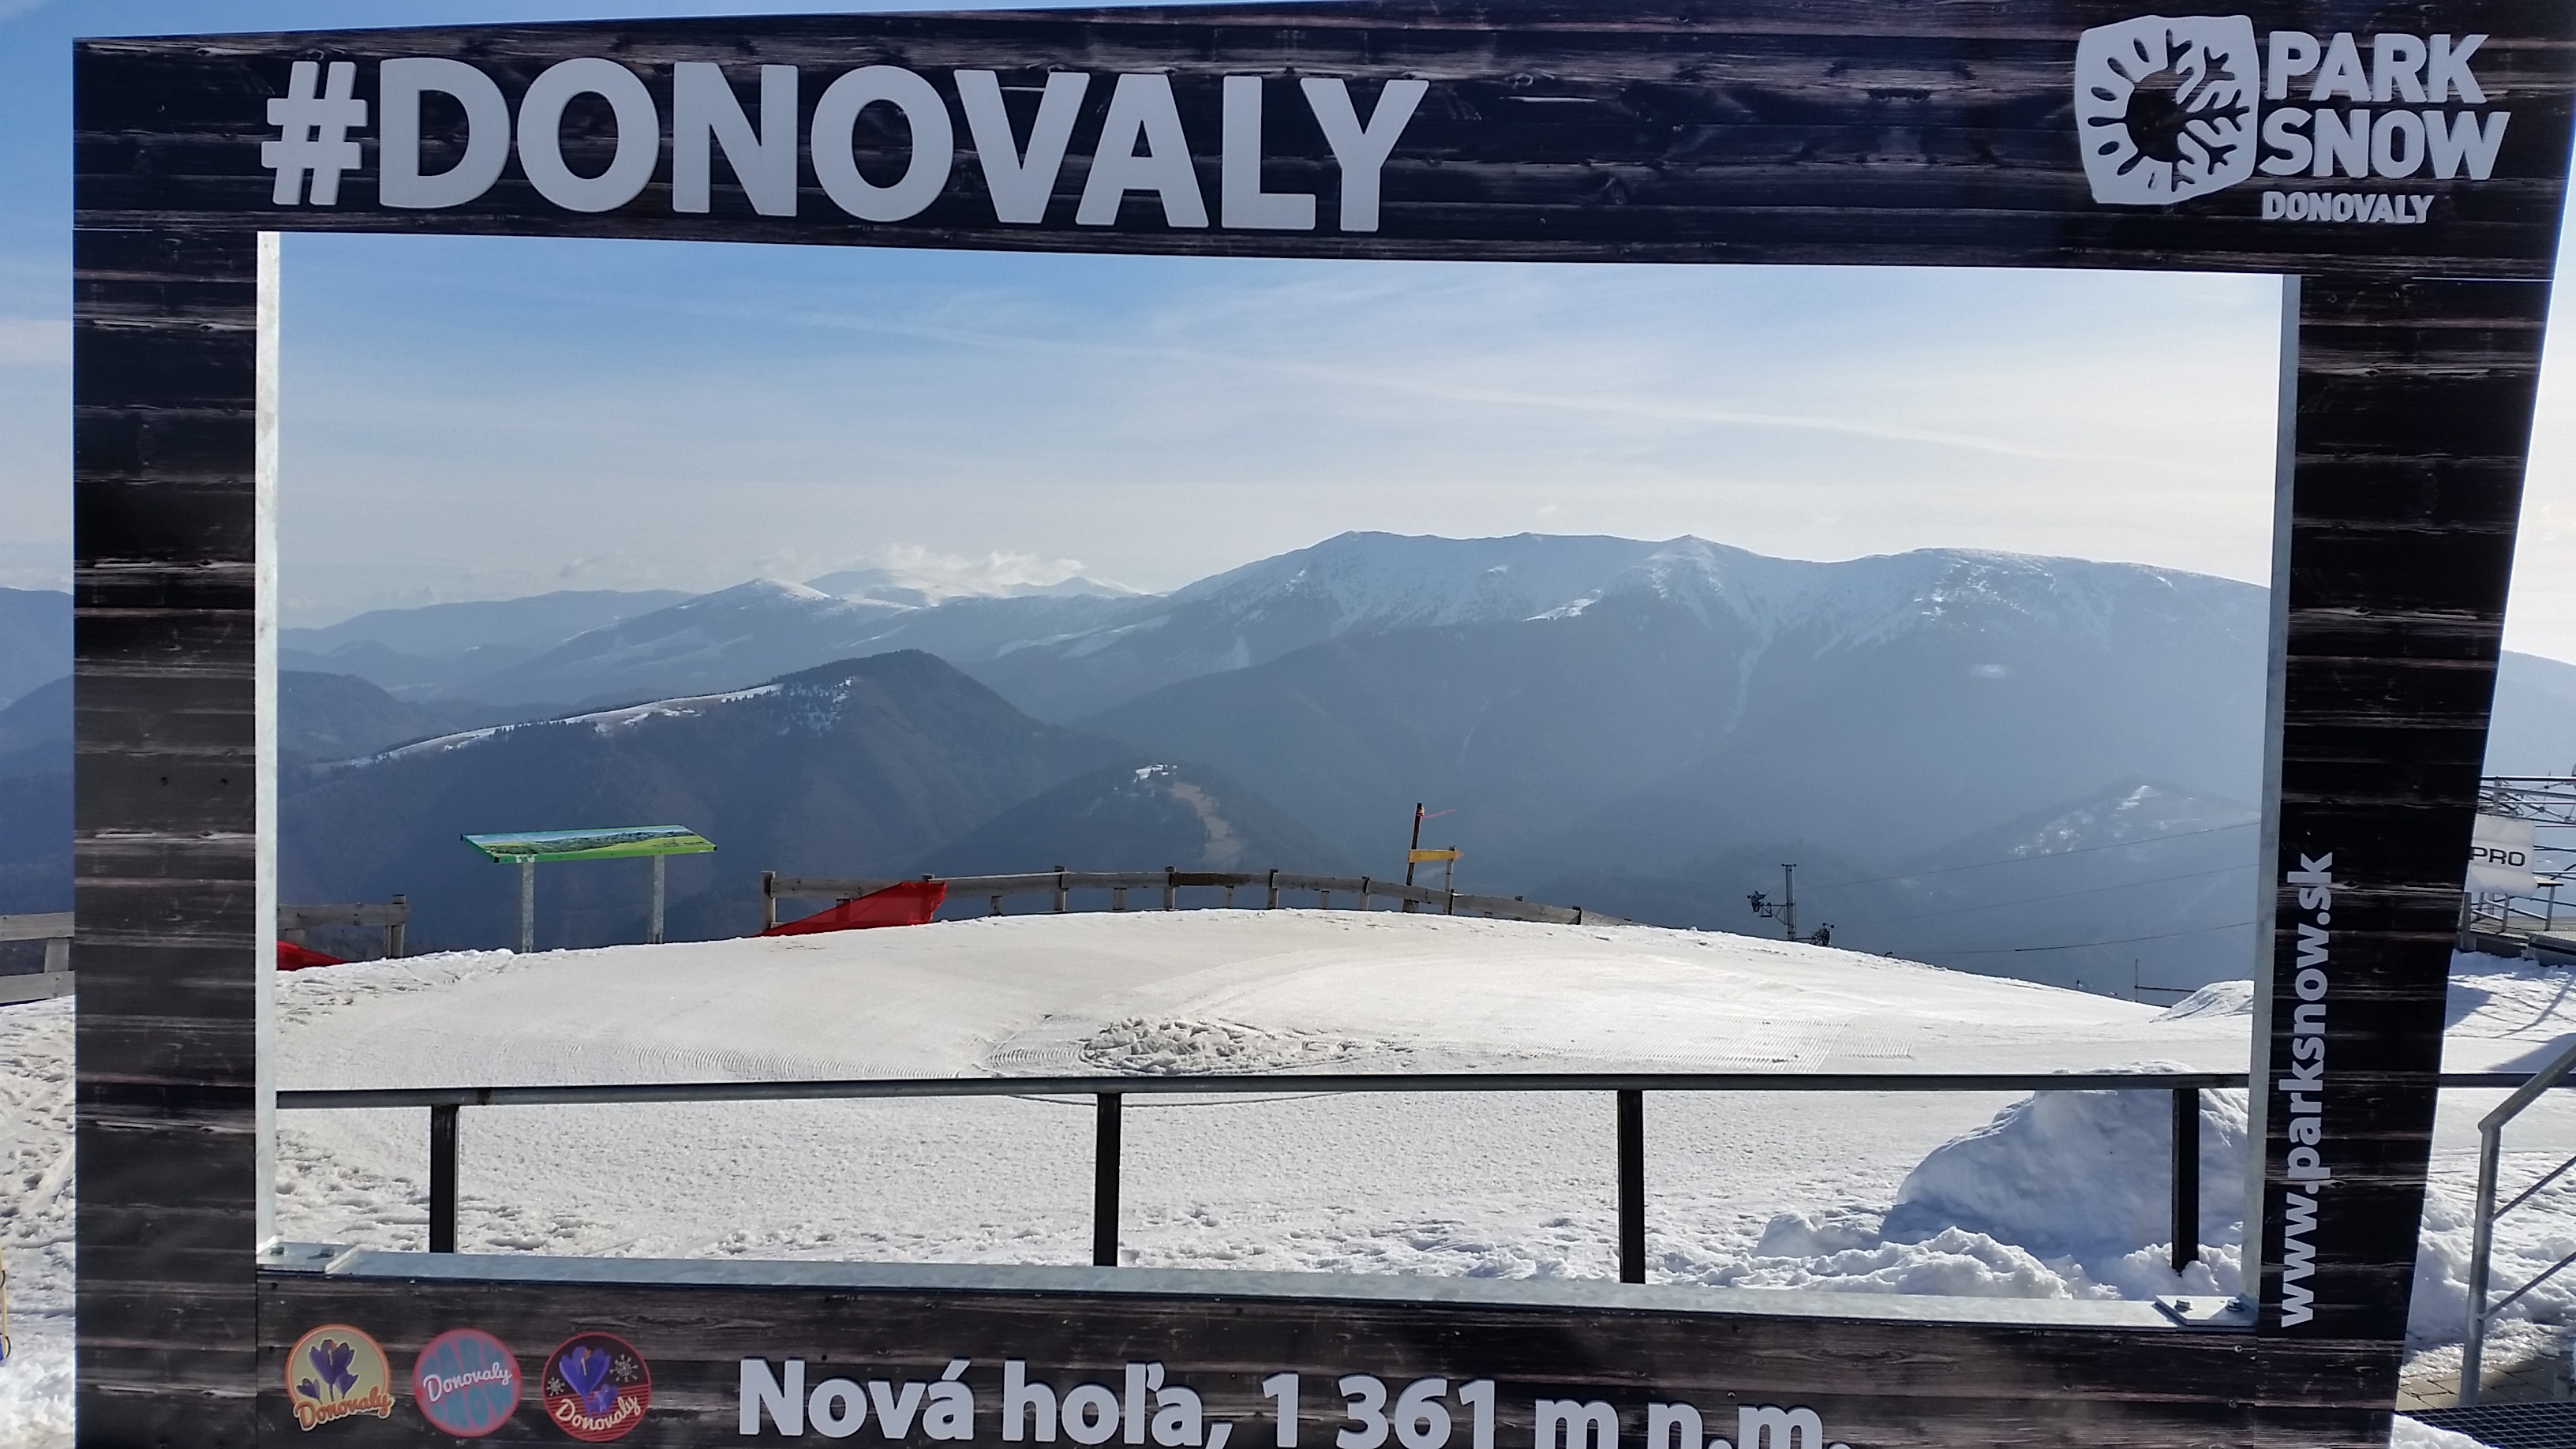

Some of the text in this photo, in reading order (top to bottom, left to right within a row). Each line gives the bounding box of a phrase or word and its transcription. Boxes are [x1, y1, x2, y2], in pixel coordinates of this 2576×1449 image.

[2267, 31, 2489, 103] PARK
[260, 57, 1430, 232] #DONOVALY
[2259, 107, 2511, 180] SNOW
[2263, 191, 2435, 223] DONOVALY
[2469, 847, 2525, 867] PRO
[2279, 851, 2333, 1328] www.parksnow.sk
[294, 1386, 391, 1429] Donovaly
[424, 1361, 513, 1402] Donovaly
[739, 1358, 975, 1440] Nová
[1263, 1373, 1299, 1448] 1
[1336, 1375, 1496, 1449] 361
[1535, 1398, 1619, 1449] m
[1648, 1402, 1851, 1449] nm
[556, 1396, 641, 1431] Donovaly
